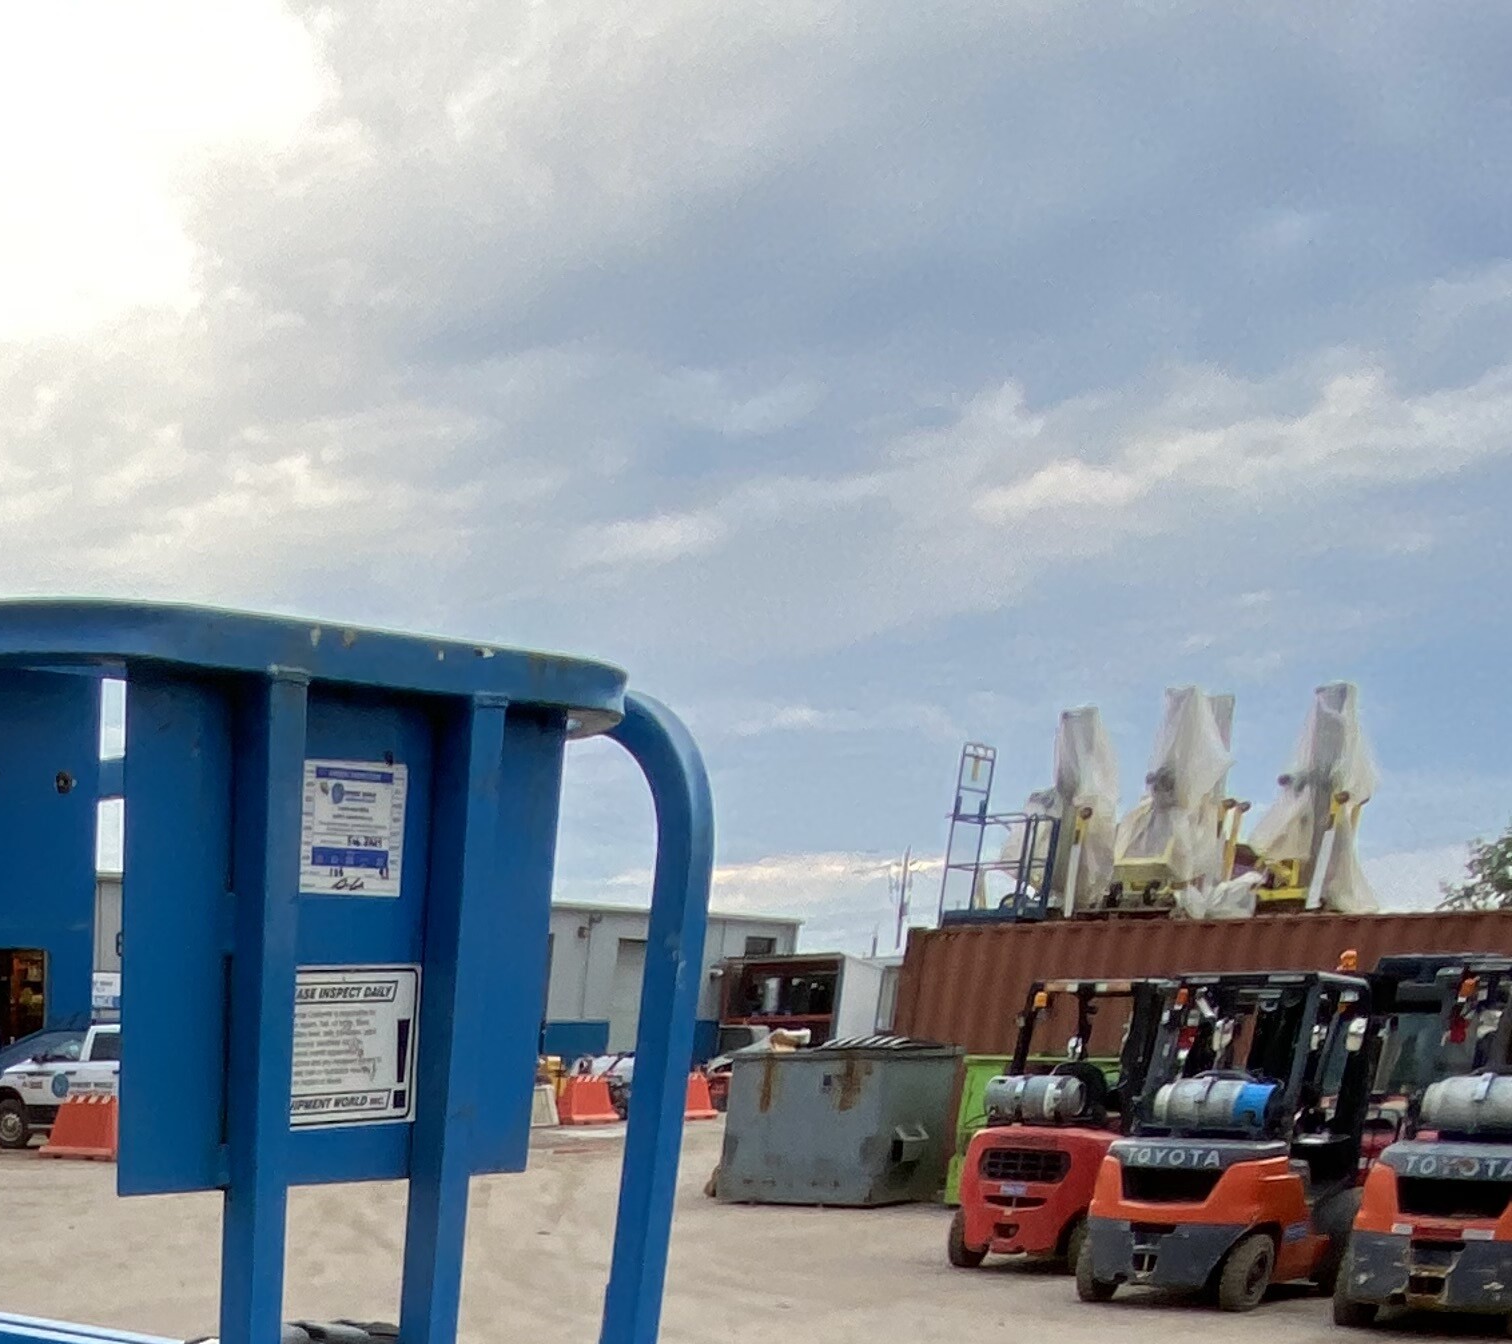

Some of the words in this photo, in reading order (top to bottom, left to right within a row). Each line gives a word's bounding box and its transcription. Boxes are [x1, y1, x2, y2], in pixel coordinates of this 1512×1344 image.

[319, 986, 362, 999] INSPECT
[363, 985, 393, 998] DAILY
[333, 1096, 368, 1108] WORLD
[1127, 1146, 1221, 1167] TOYOTA
[1405, 1155, 1512, 1178] TOYOTA
